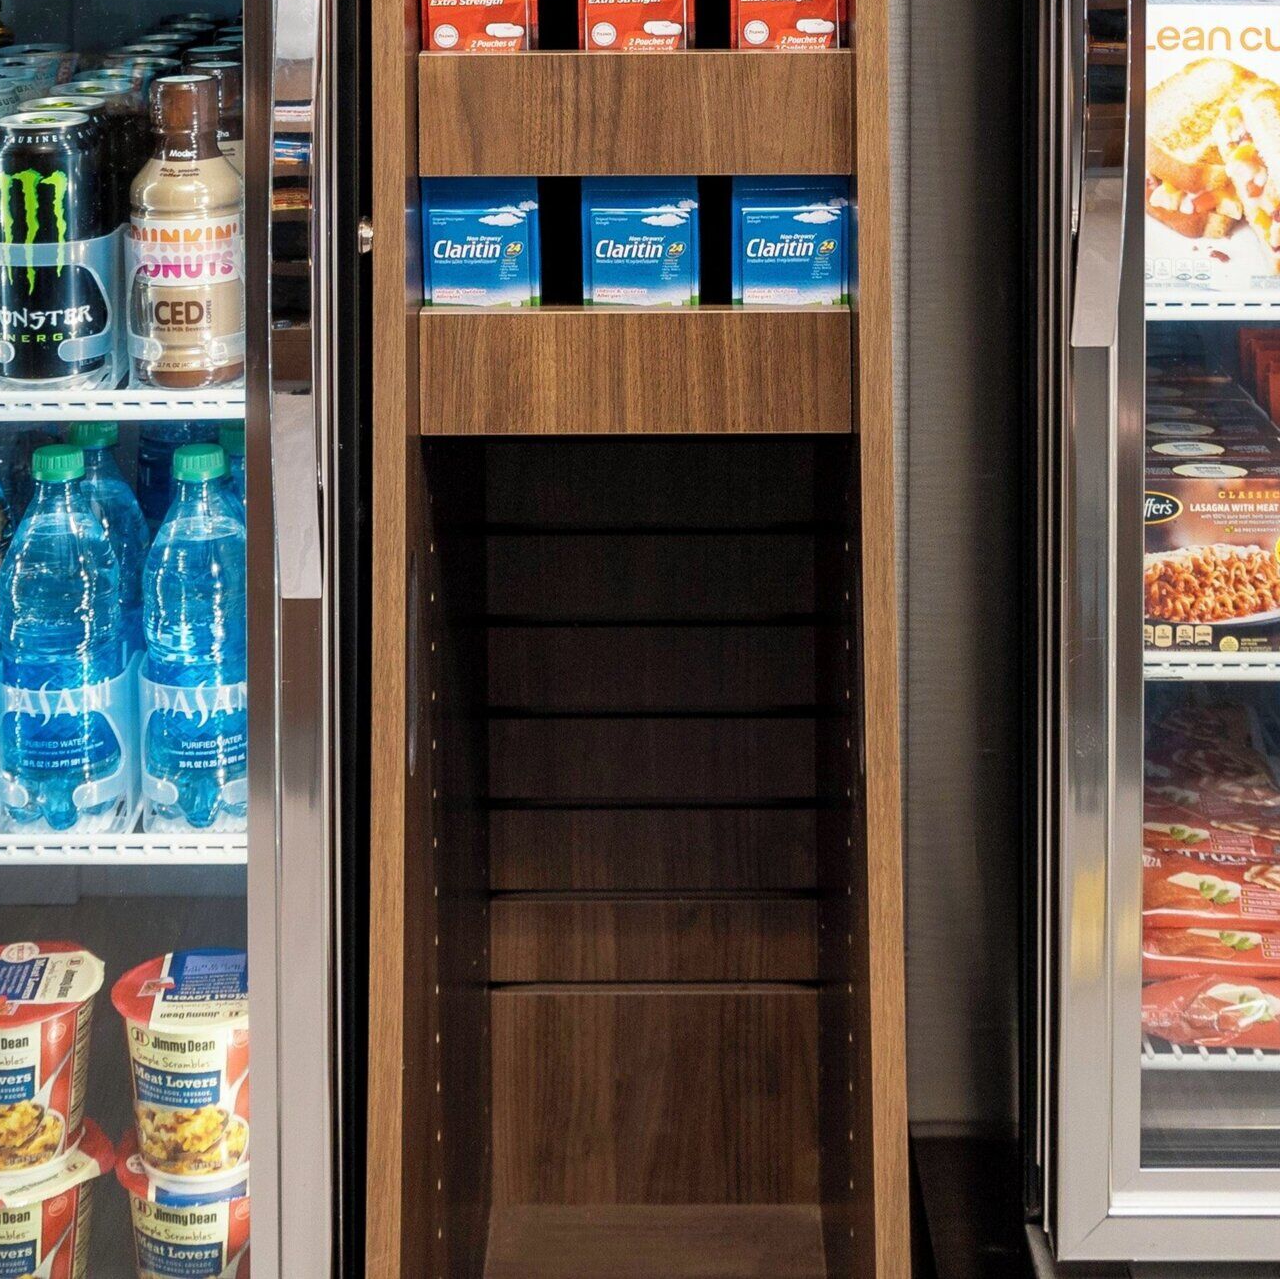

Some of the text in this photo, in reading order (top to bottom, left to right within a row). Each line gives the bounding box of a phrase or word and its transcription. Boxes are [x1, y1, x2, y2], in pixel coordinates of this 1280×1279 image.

[169, 150, 195, 158] Mocha
[434, 240, 500, 258] Claritin
[507, 244, 520, 254] 24
[595, 240, 662, 258] Claritin
[746, 238, 813, 257] Claritin
[1190, 504, 1230, 513] LASAGNA
[1232, 504, 1253, 512] WITH
[1255, 503, 1278, 512] MEAT
[1, 1036, 29, 1048] Dean
[187, 1039, 214, 1051] Dean
[167, 1075, 217, 1088] Lovers
